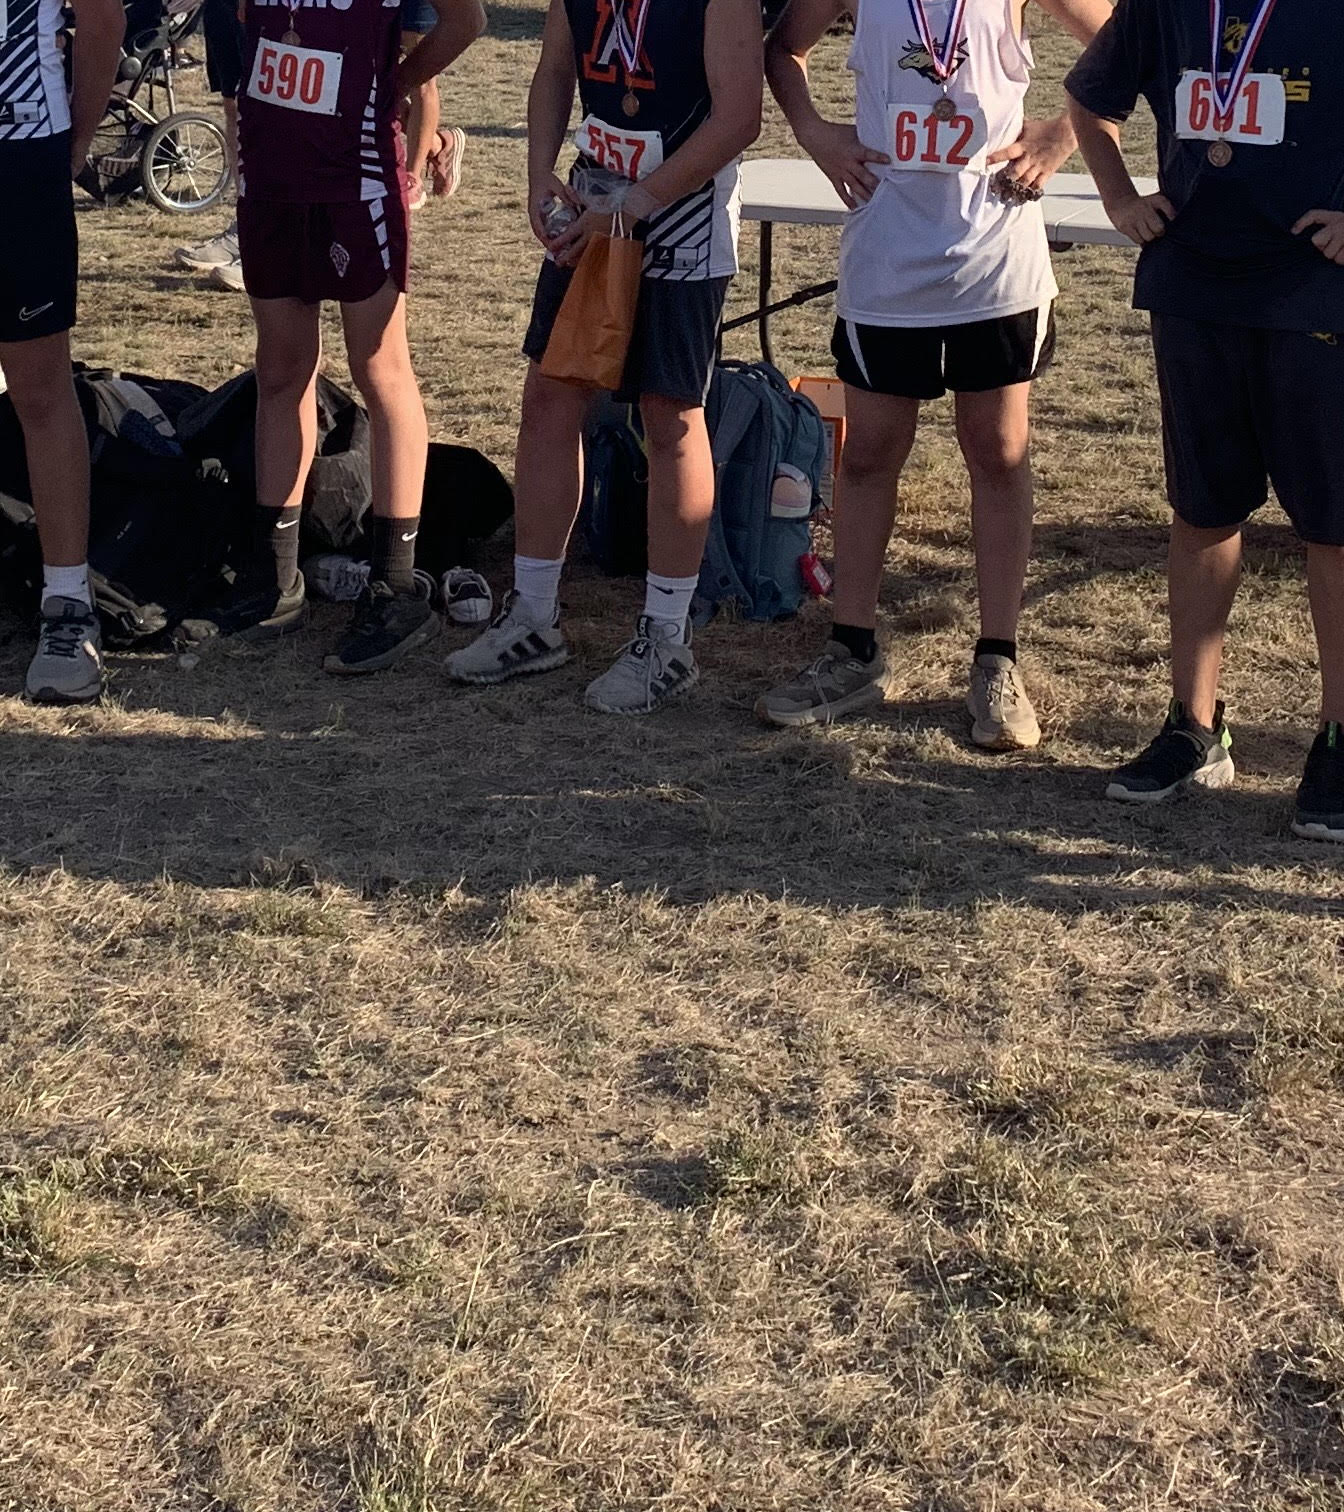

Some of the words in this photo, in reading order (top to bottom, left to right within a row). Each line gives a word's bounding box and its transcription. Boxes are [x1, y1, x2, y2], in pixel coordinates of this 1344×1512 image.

[258, 47, 325, 105] 590
[588, 123, 646, 183] 557
[896, 111, 974, 166] 612
